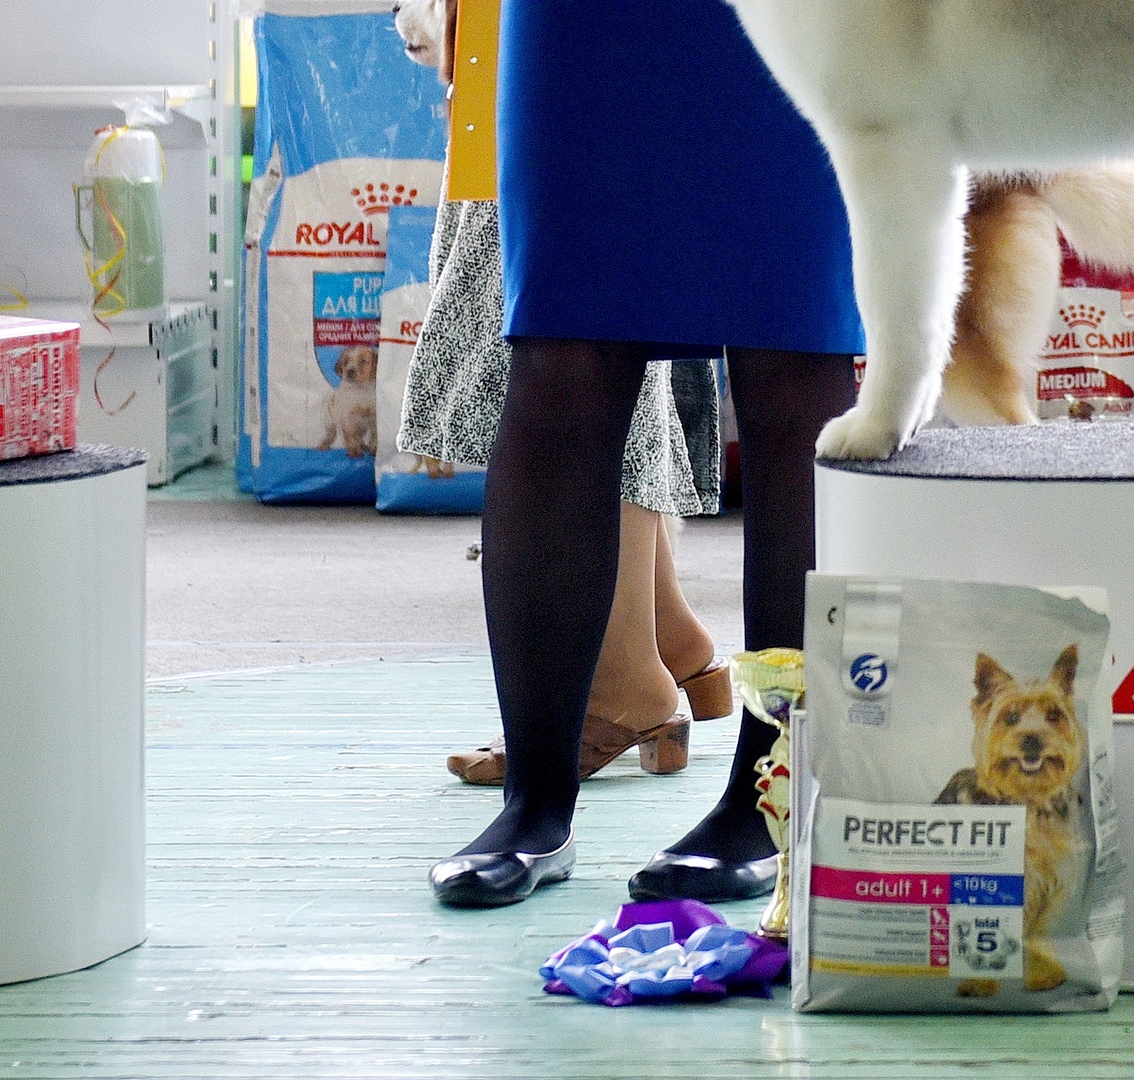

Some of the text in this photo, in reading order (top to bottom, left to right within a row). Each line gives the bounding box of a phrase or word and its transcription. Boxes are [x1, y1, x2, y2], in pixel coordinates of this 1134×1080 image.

[295, 221, 381, 245] ROYAL
[1049, 331, 1080, 350] YAL
[1040, 372, 1107, 391] MEDIUM
[843, 815, 1012, 846] PERFECT FIT
[855, 878, 944, 898] adult 1+
[976, 931, 998, 953] 5
